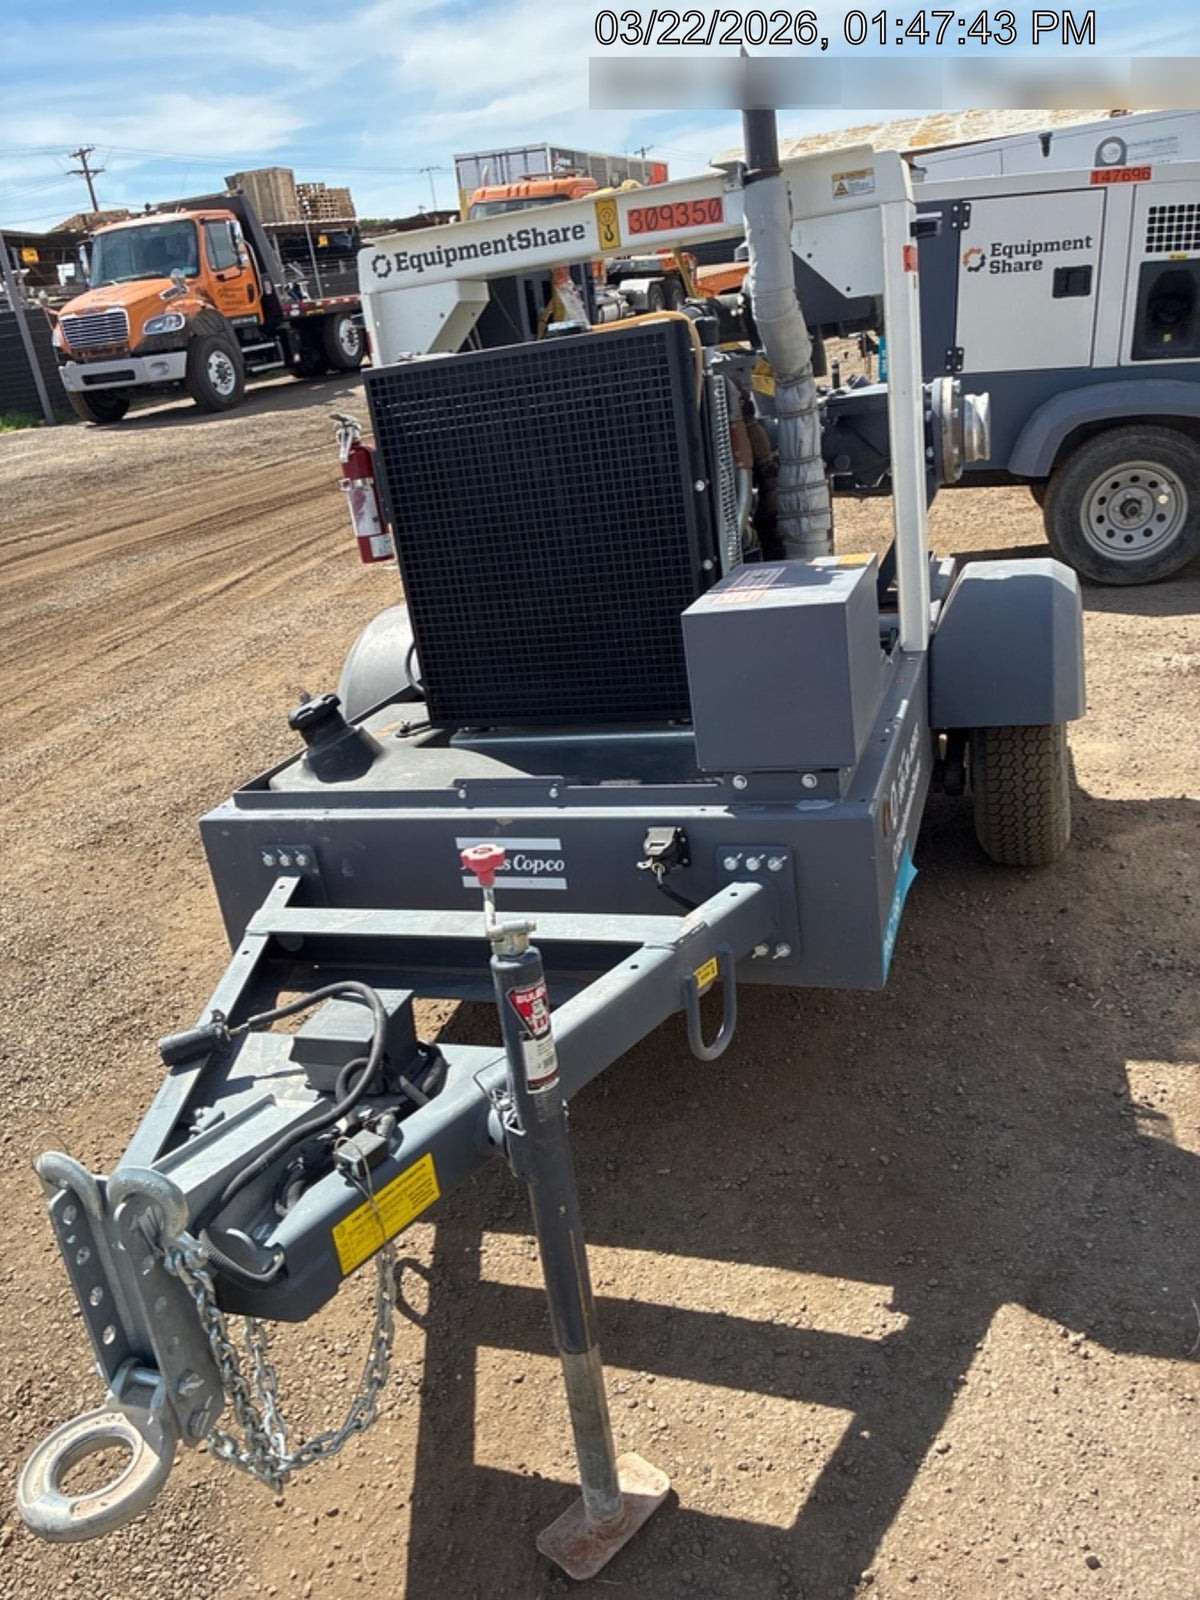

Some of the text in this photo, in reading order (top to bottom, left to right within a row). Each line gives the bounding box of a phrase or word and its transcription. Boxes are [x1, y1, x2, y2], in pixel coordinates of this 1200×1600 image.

[1090, 166, 1151, 184] 147696
[629, 198, 723, 234] 309350
[394, 222, 587, 273] EquipmentShare
[990, 235, 1093, 258] Equipment
[989, 257, 1043, 275] Share
[513, 854, 565, 874] Copco
